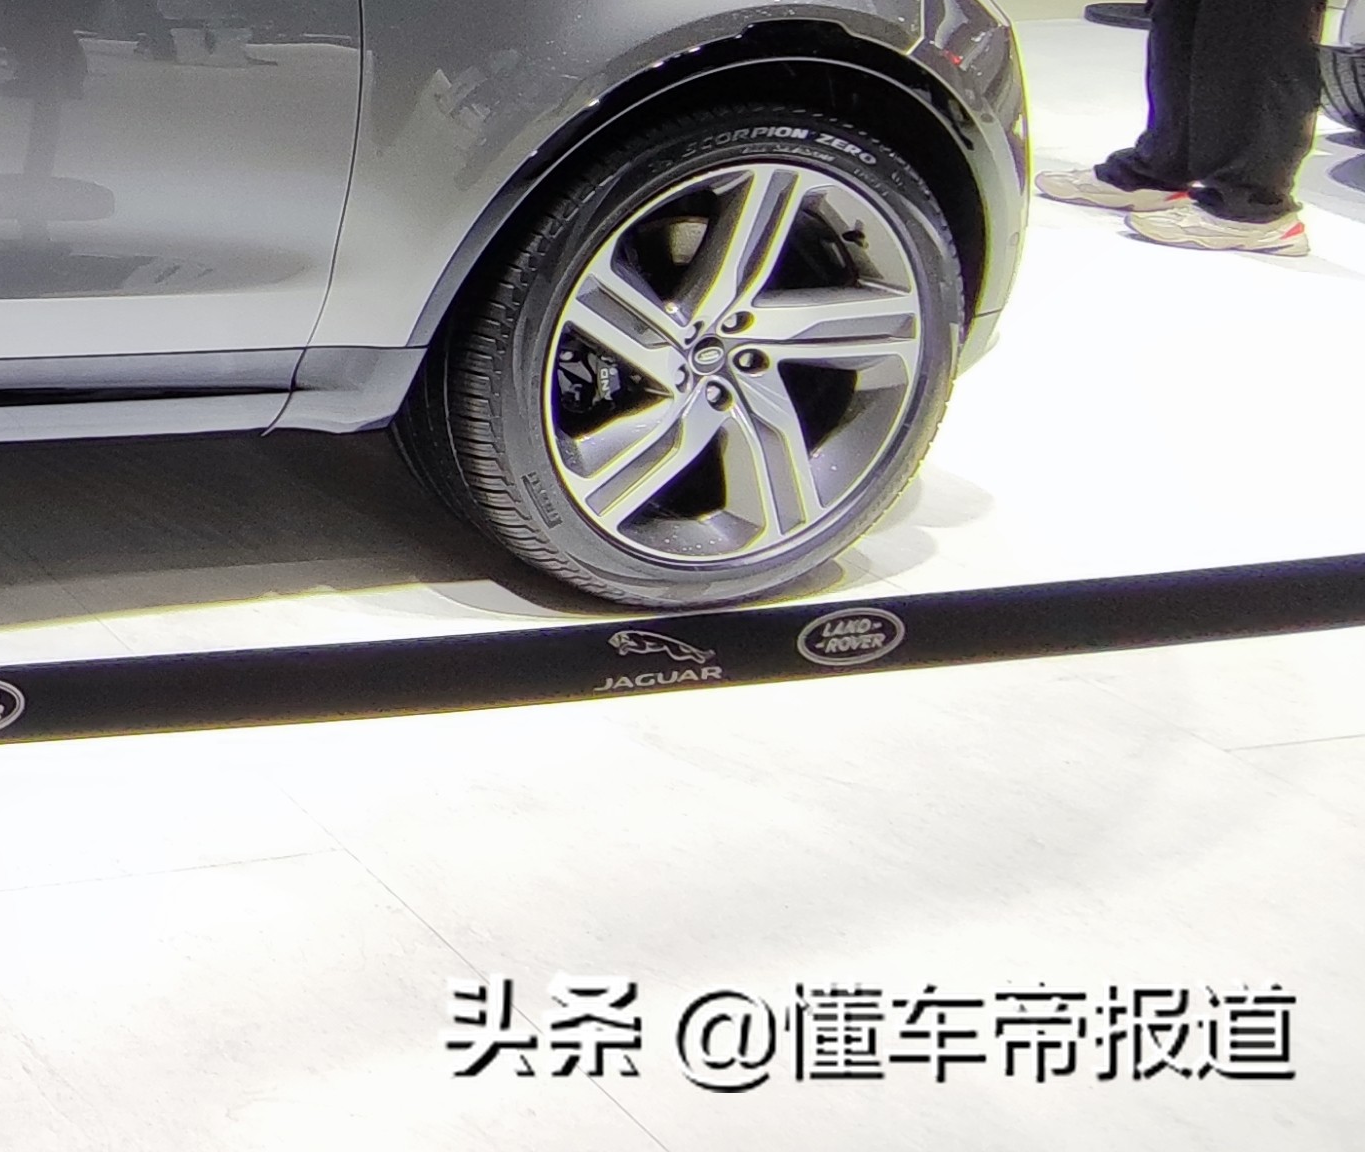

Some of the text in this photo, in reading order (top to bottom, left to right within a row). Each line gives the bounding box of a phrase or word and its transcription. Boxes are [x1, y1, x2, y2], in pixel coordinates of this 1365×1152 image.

[681, 125, 878, 165] SCORPION ZERO
[593, 665, 724, 692] JAGUAR
